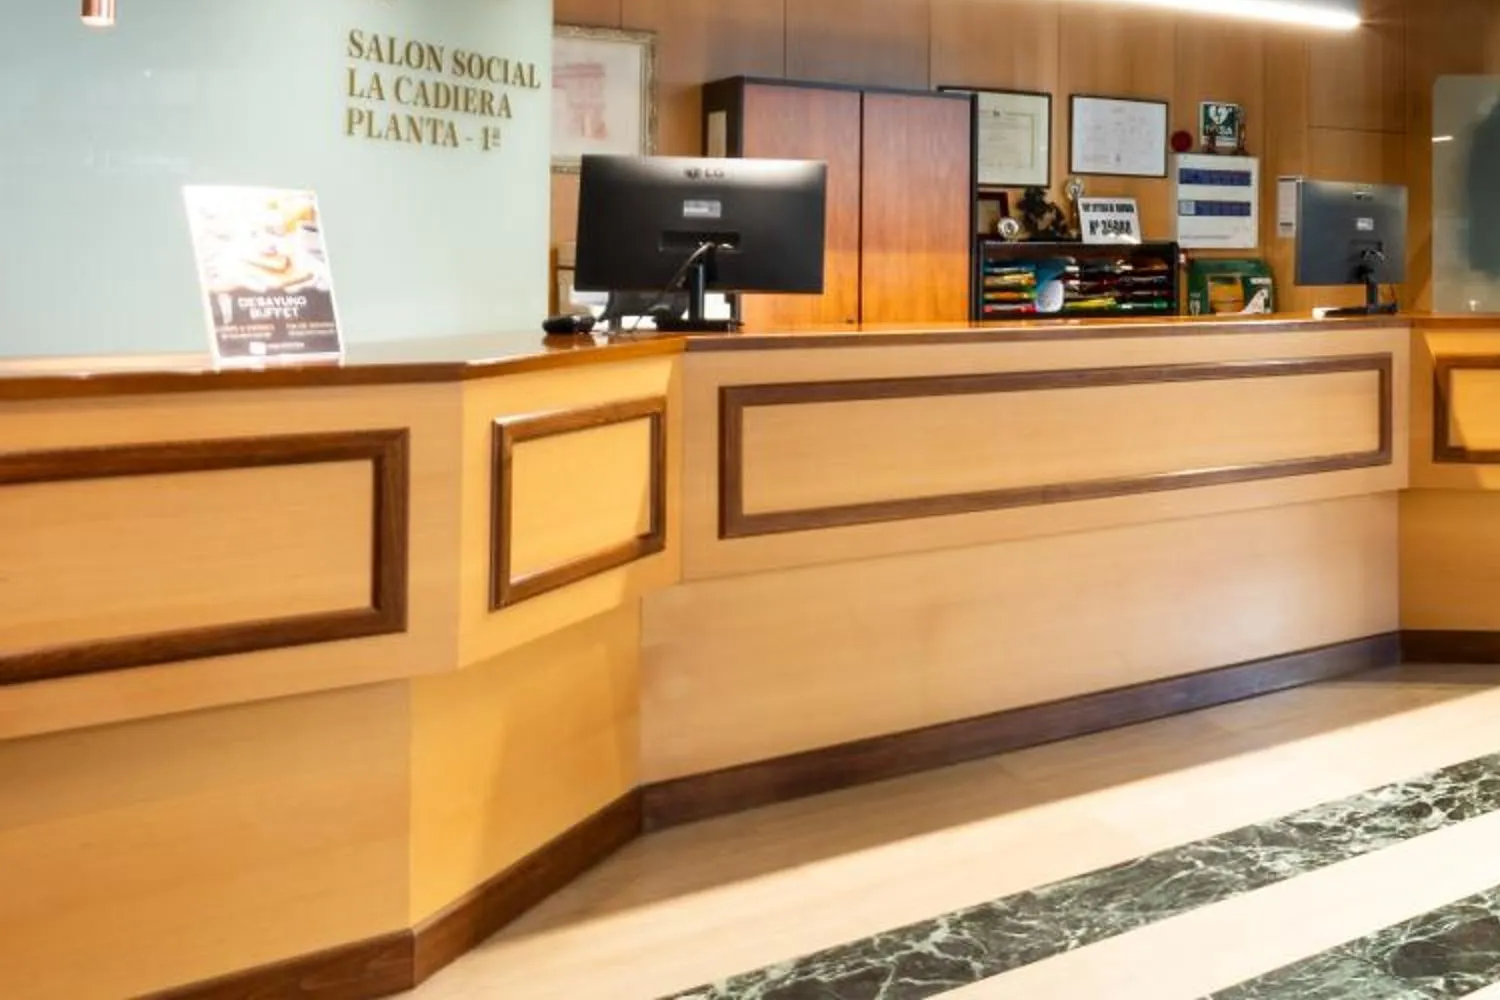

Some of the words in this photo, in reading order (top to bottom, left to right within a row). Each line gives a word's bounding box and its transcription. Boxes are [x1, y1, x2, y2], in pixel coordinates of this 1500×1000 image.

[348, 29, 444, 73] SALON
[452, 49, 541, 90] SOCIAL
[347, 67, 385, 101] LA
[394, 75, 513, 119] CADIERA
[346, 107, 459, 148] PLANTA
